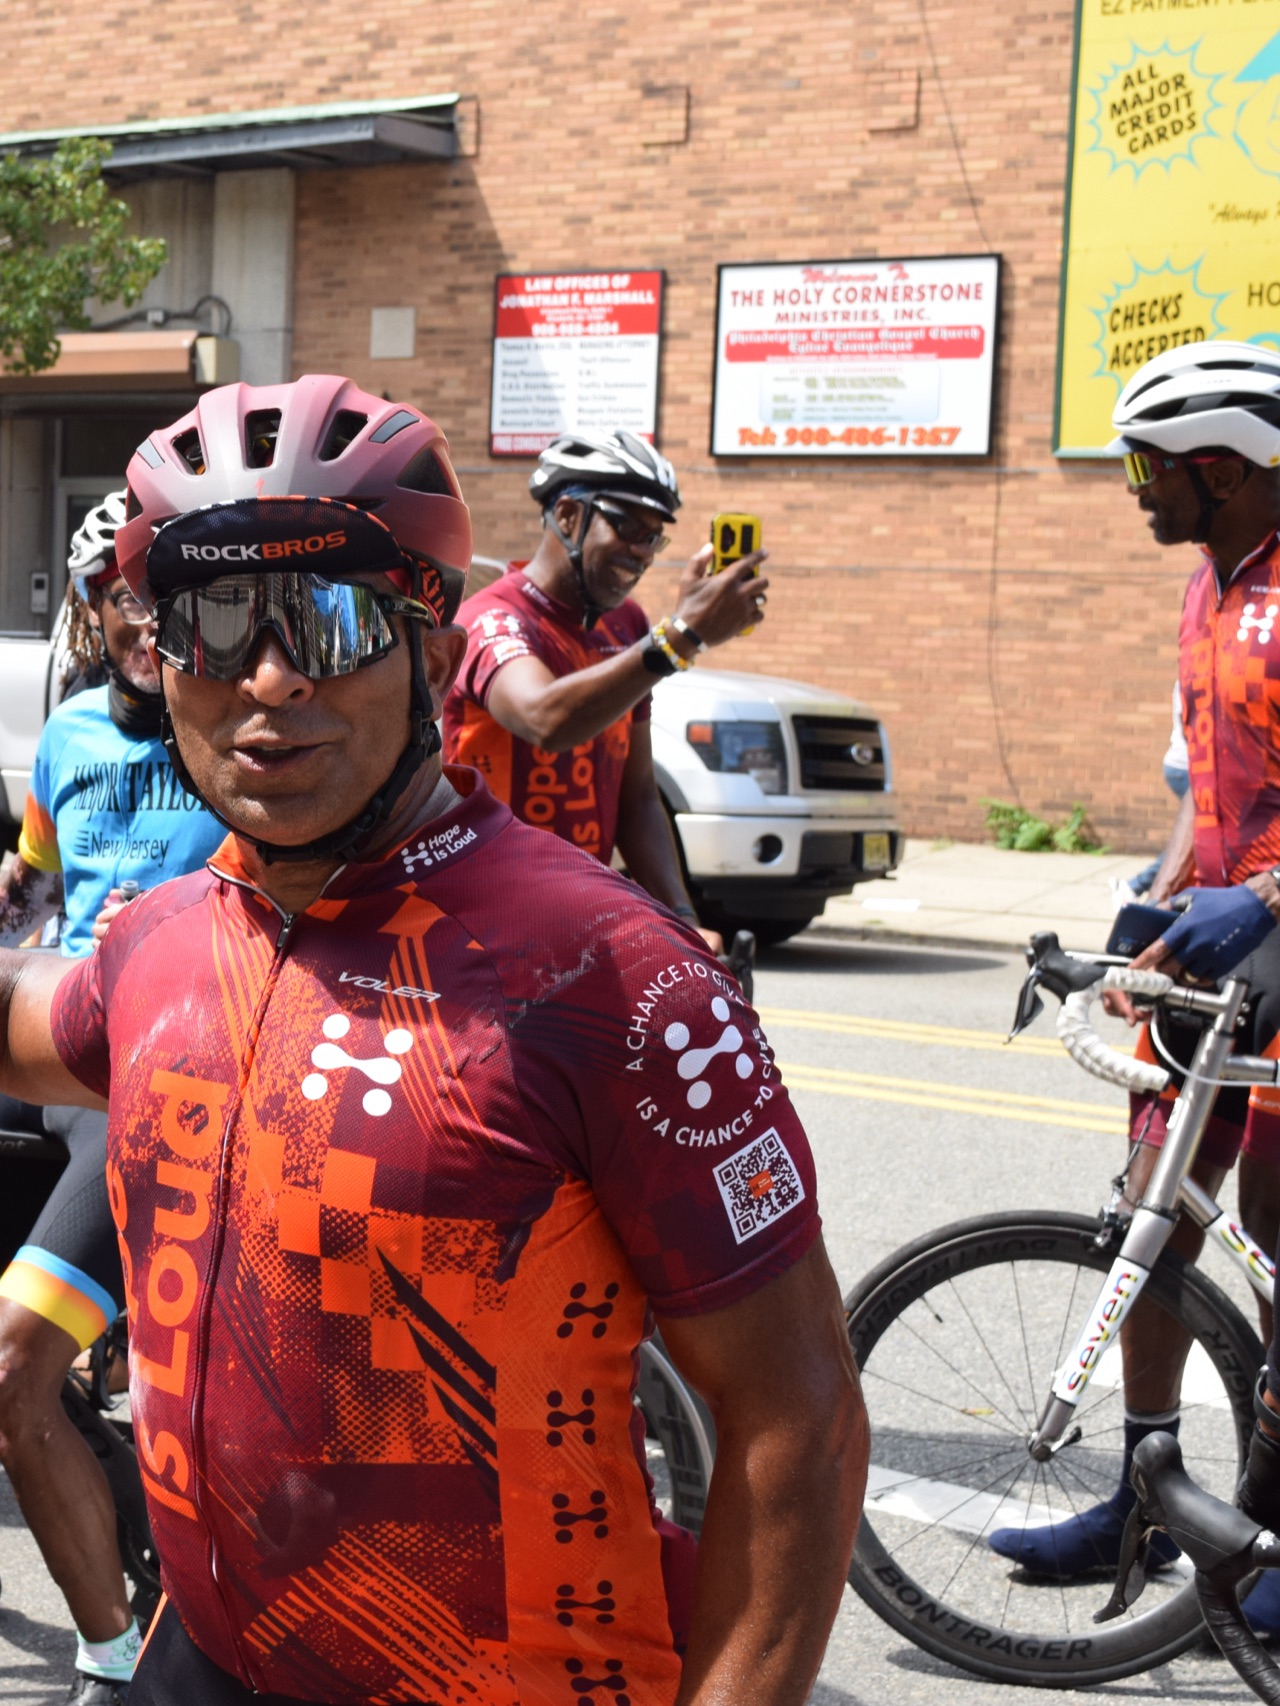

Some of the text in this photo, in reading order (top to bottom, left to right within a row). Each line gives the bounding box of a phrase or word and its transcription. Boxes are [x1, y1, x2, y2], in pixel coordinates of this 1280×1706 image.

[1131, 0, 1218, 13] PAYM
[1123, 64, 1158, 90] ALL
[1110, 74, 1185, 119] MAJOR
[1117, 91, 1193, 137] CREDIT
[1129, 112, 1197, 154] CARDS
[500, 293, 569, 309] JONATHAN
[583, 290, 655, 305] MARSHALL
[525, 274, 631, 292] LAW OFFICES OF
[731, 283, 984, 307] THE HOLY CORNERSTONE
[894, 308, 931, 321] INC.
[1110, 293, 1182, 333] CHECKS
[929, 325, 979, 340] Church
[181, 530, 347, 561] ROCKBROS
[125, 762, 208, 812] TAYLO
[524, 745, 568, 832] ope
[565, 741, 597, 811] Lou
[1195, 787, 1218, 828] Is
[122, 834, 170, 868] Jersey
[428, 825, 460, 850] Hope
[433, 828, 477, 861] Is Loud
[682, 961, 708, 978] TO
[338, 972, 441, 1003] VOLER
[626, 964, 683, 1051] CHANCE
[626, 1057, 644, 1071] A
[636, 1096, 658, 1120] IS
[653, 1118, 670, 1137] A
[675, 1110, 753, 1147] CHANCE
[754, 1085, 773, 1109] TO
[135, 1068, 232, 1522] Is Loud
[1067, 1270, 1138, 1395] seven
[873, 1562, 1094, 1662] BONTRAGER
